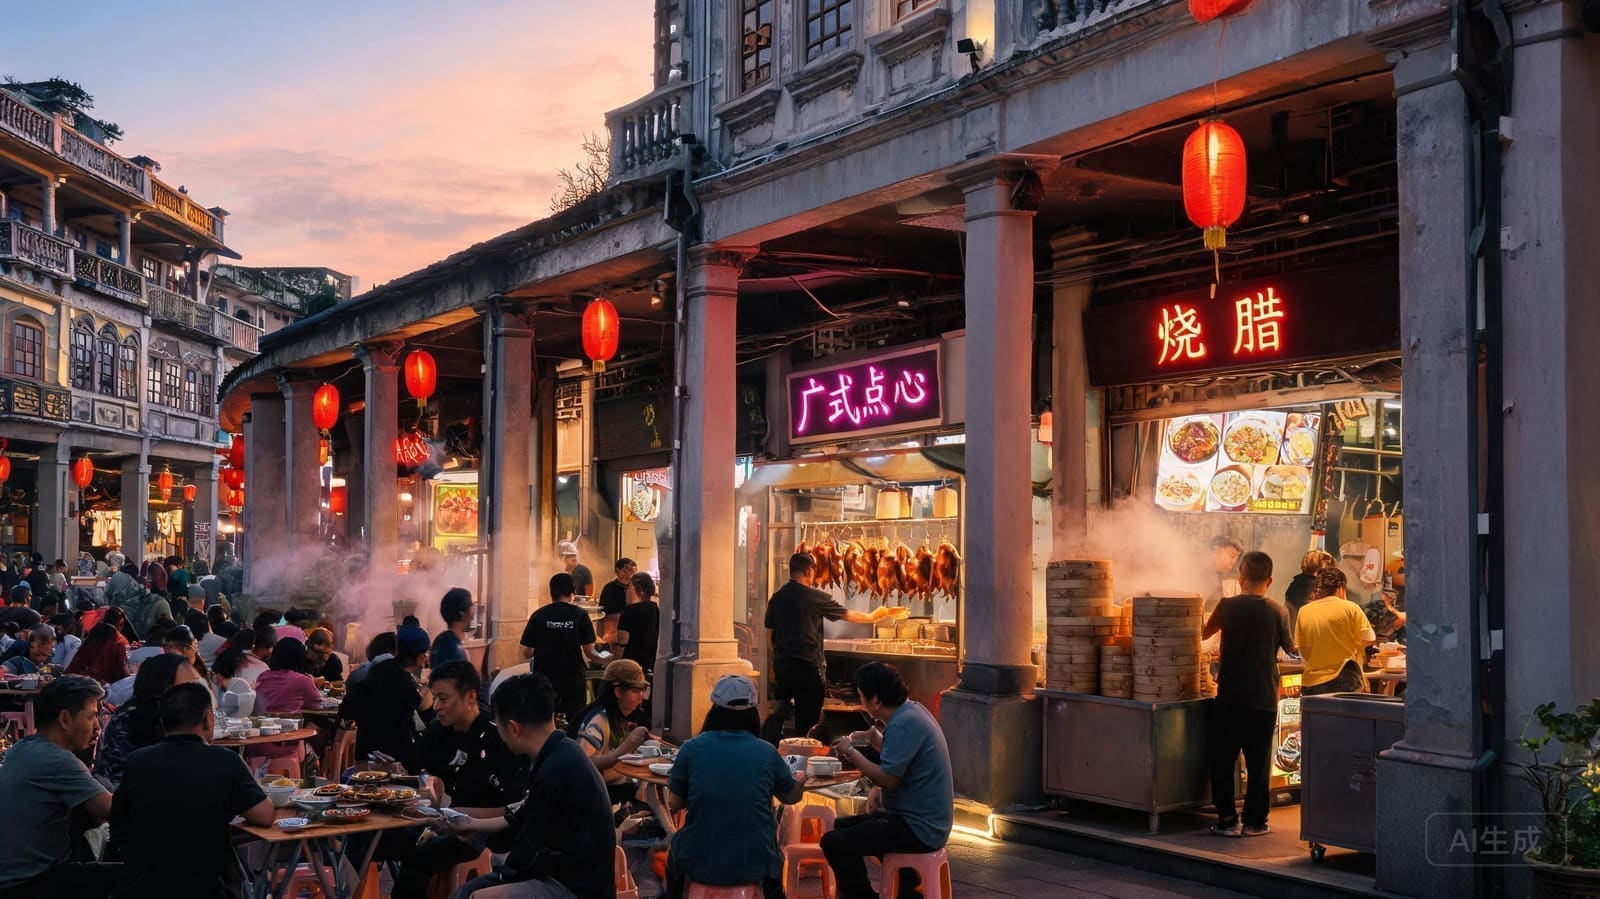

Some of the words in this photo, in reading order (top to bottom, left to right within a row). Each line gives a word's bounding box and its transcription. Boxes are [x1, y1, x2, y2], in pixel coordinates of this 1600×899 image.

[1158, 287, 1284, 365] 烧腊
[797, 366, 926, 432] 广式点心
